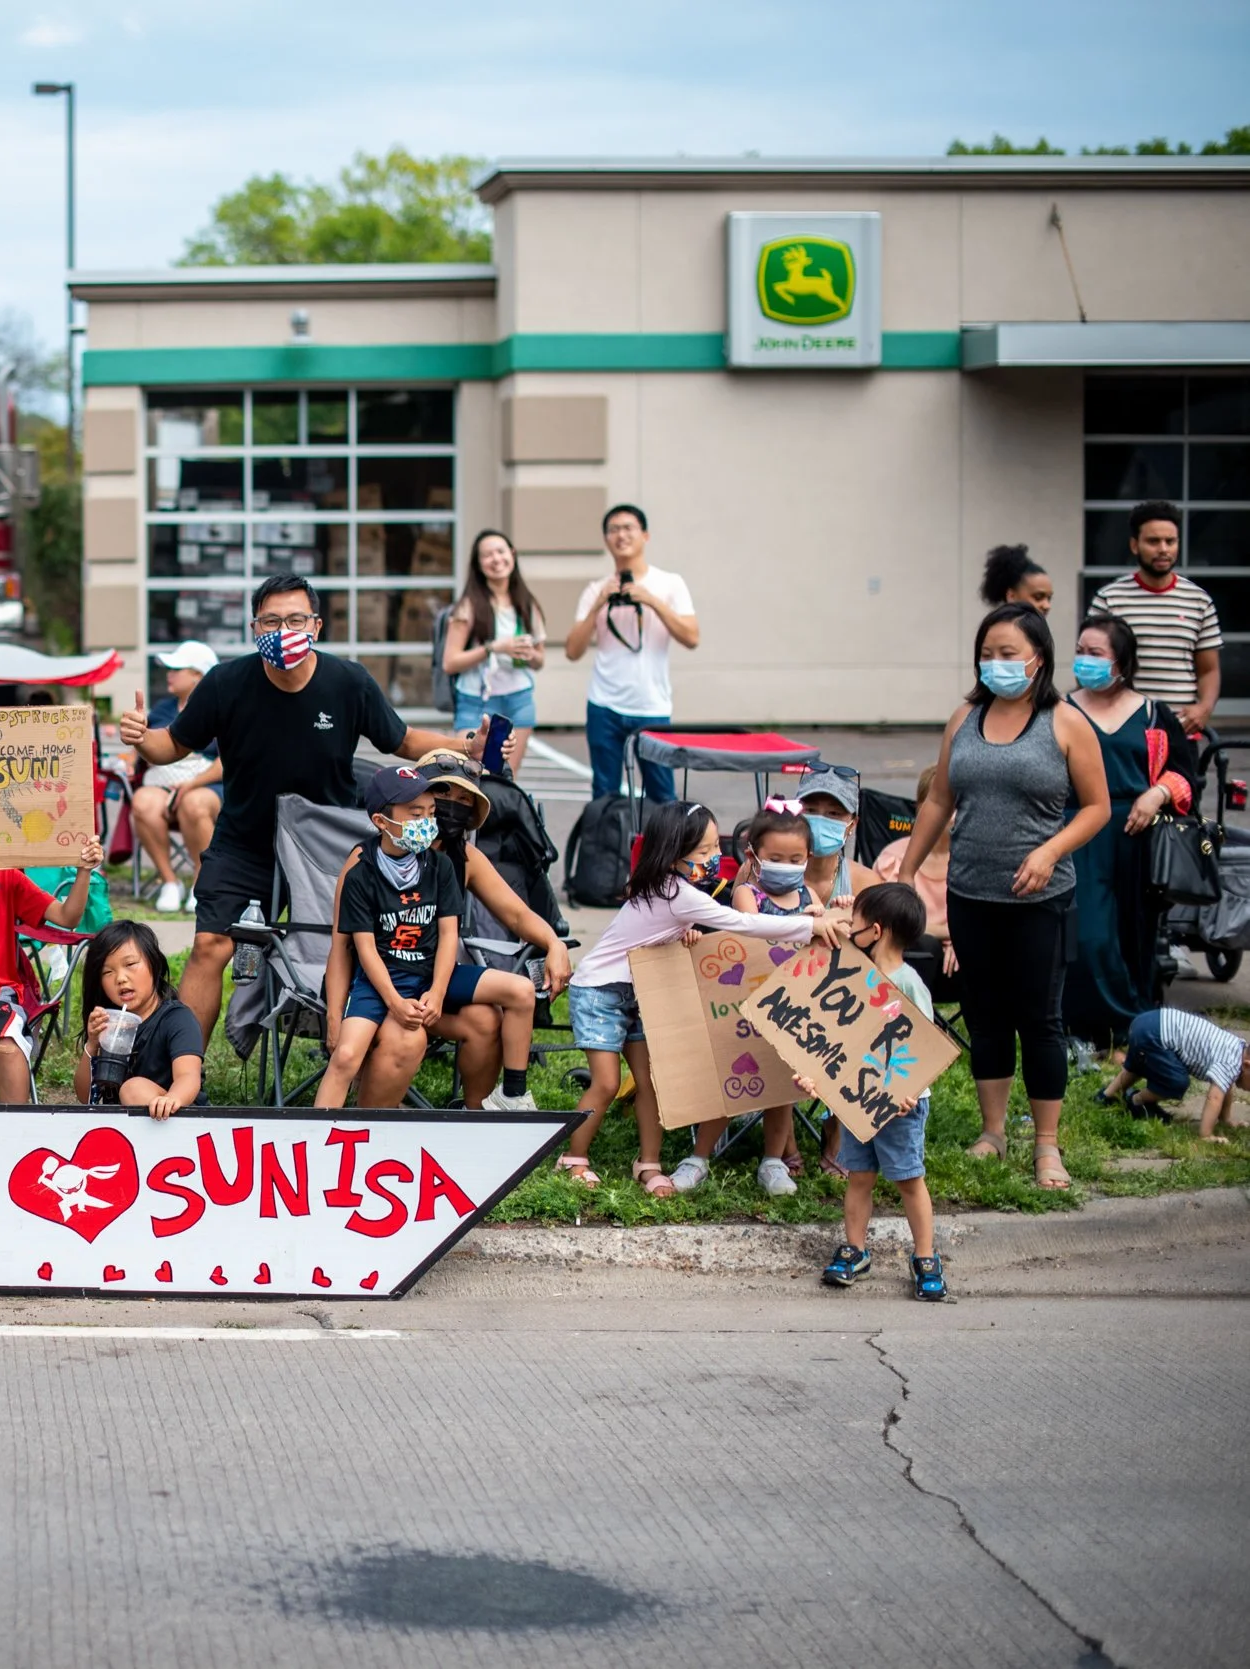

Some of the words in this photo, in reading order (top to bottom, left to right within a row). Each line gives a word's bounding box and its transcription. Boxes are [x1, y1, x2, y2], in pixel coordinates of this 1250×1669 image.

[889, 820, 912, 831] SUM
[810, 948, 864, 1026] YOU
[711, 1000, 746, 1020] lov
[735, 1018, 763, 1039] SU
[147, 1125, 478, 1238] SUNISA
